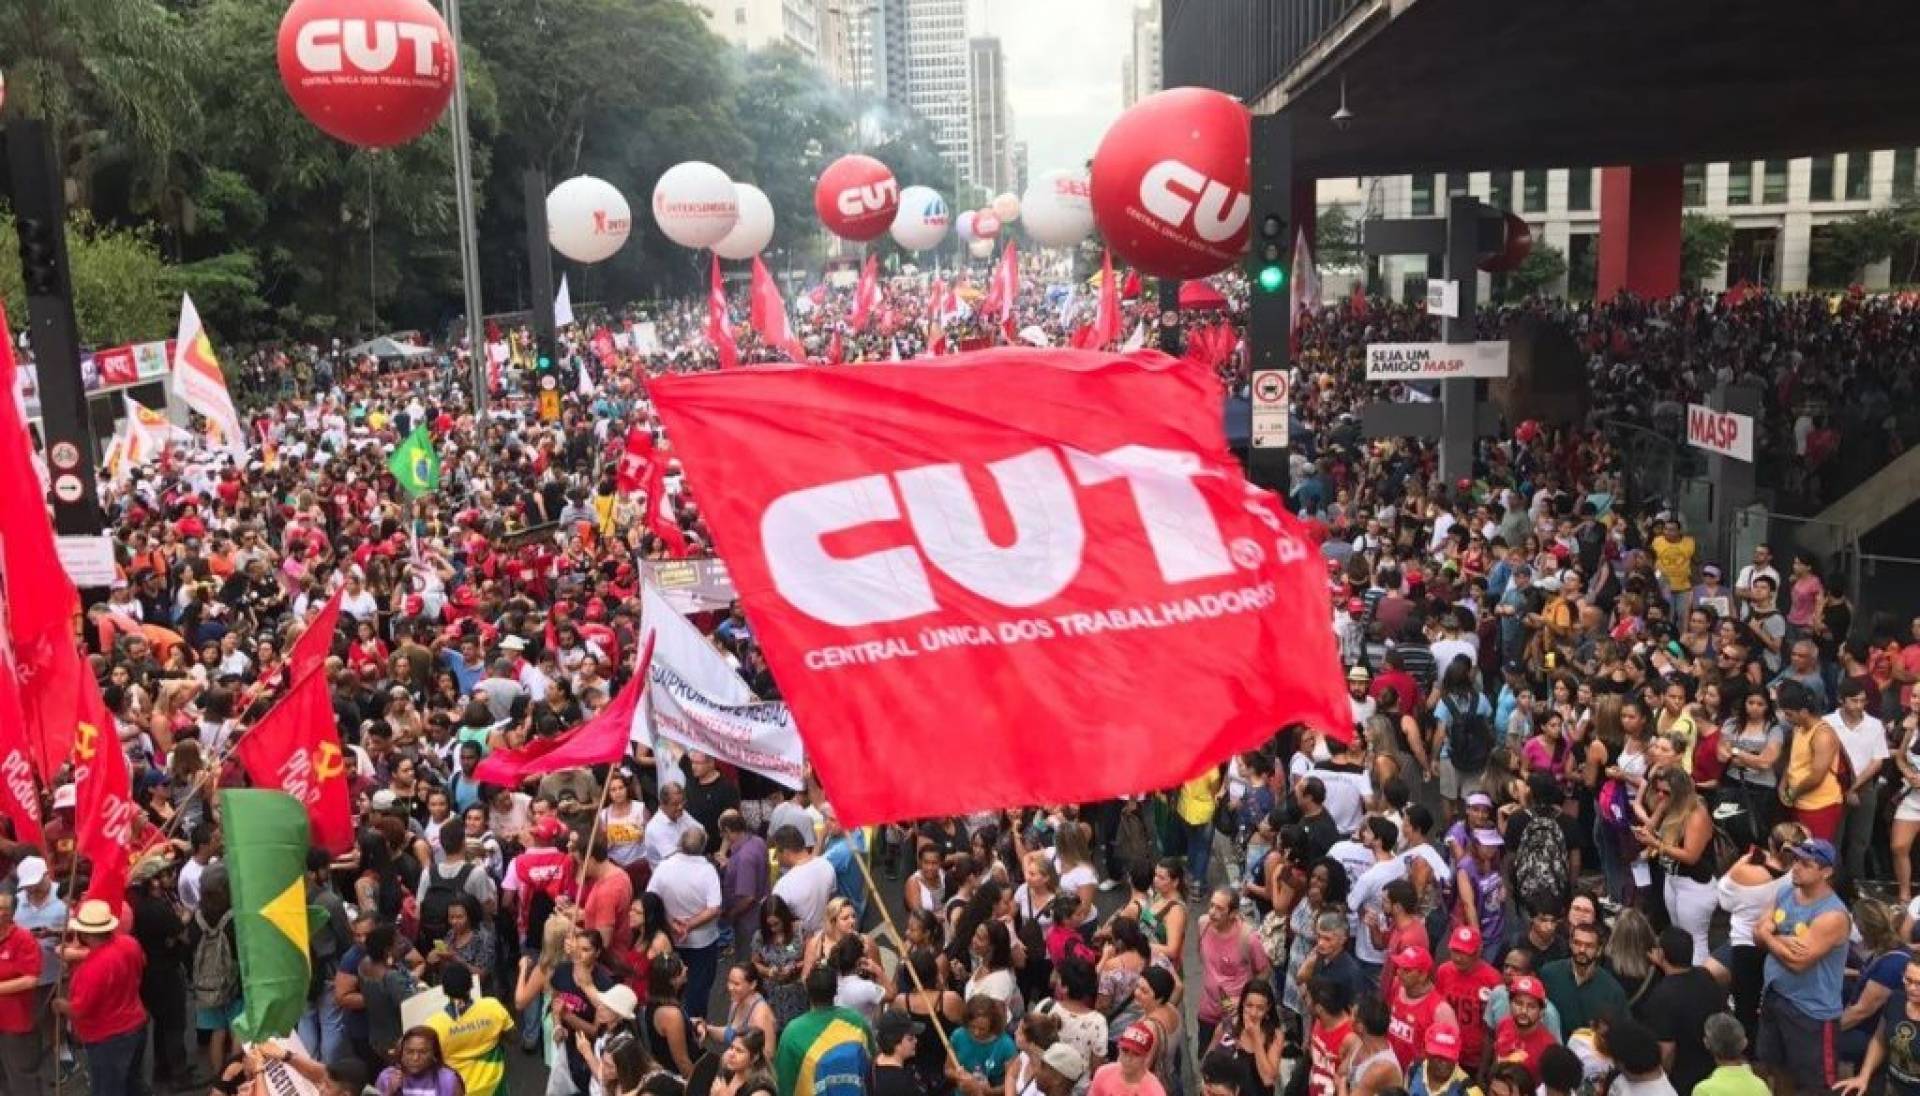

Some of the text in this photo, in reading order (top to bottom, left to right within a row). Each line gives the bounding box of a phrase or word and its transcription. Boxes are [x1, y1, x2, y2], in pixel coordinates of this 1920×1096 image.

[296, 18, 440, 76] CUT
[837, 178, 897, 216] CUT
[1371, 359, 1464, 373] AMIGO MASP
[1372, 348, 1430, 361] SEJA UM
[1690, 408, 1738, 451] MASP
[760, 443, 1237, 626] CUT
[804, 637, 918, 671] CENTRAL
[919, 625, 997, 652] ÚNICA
[999, 618, 1056, 645] DOS
